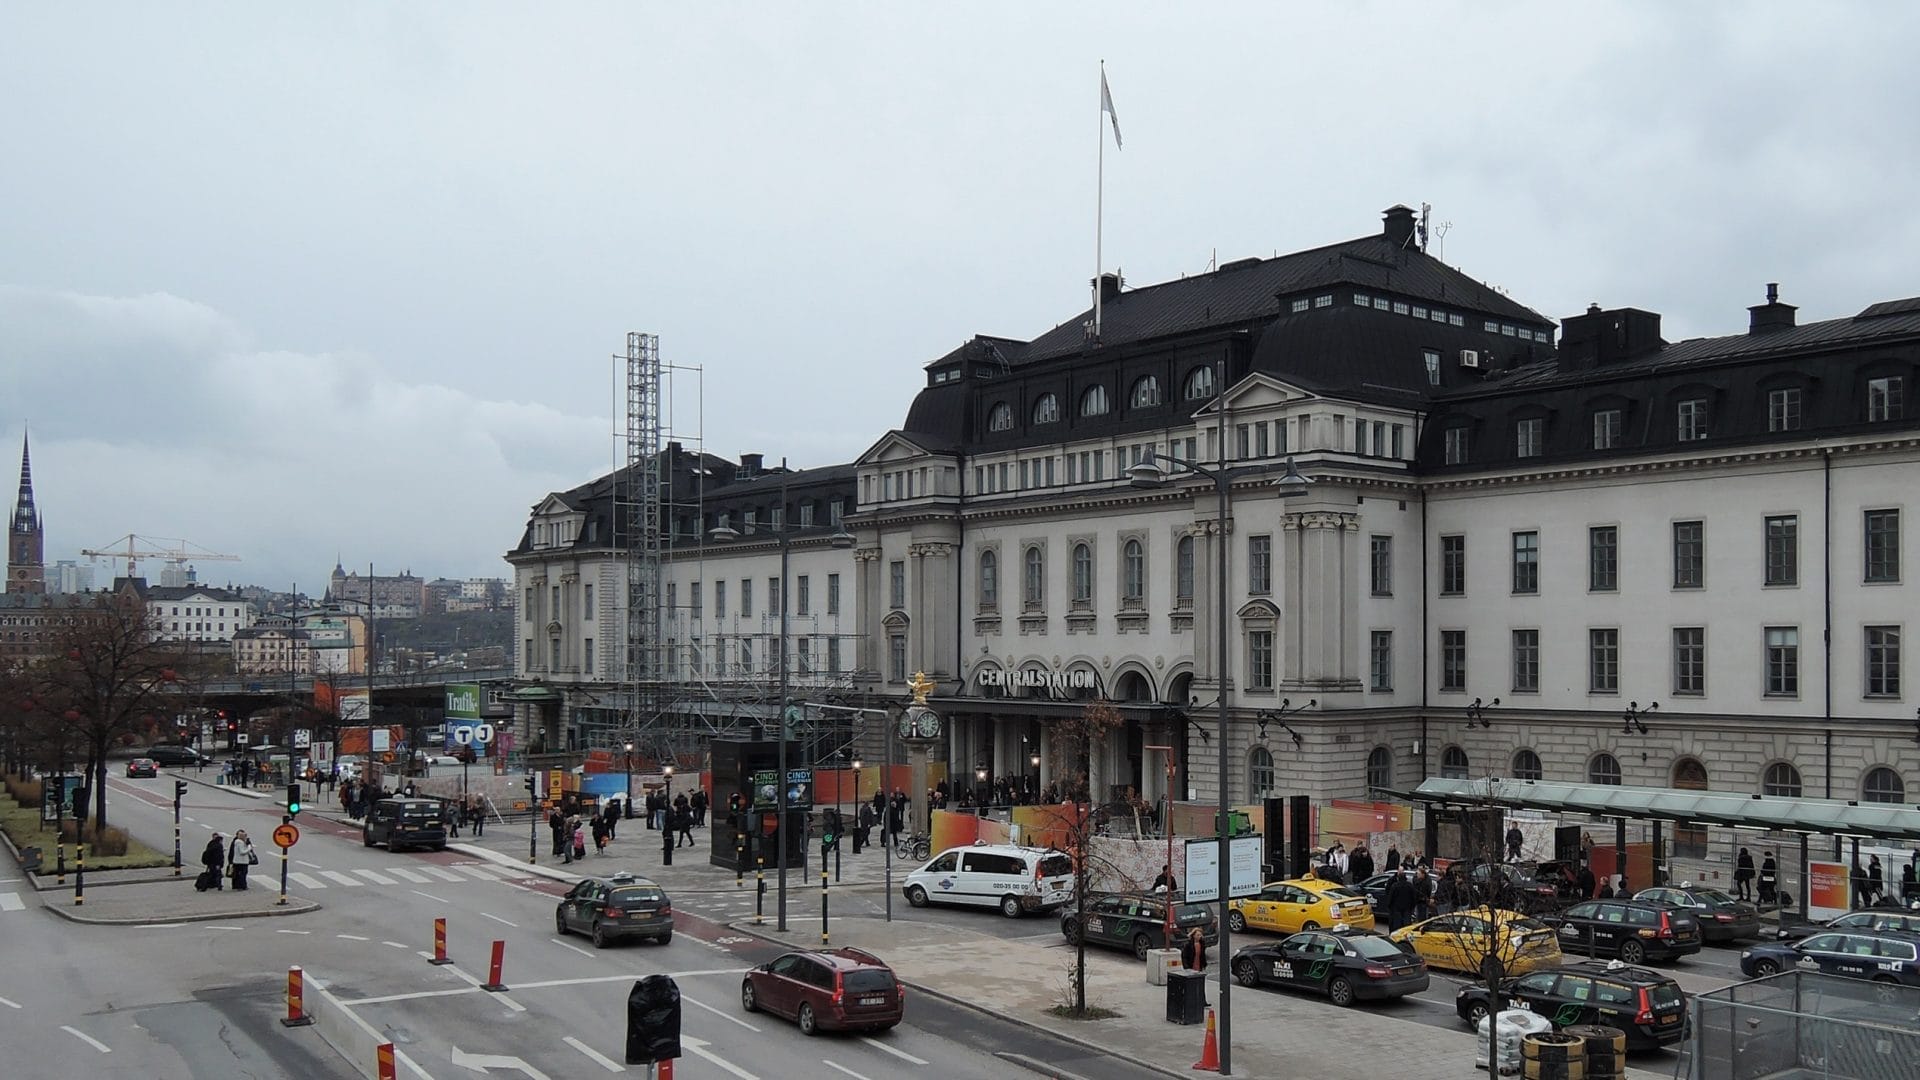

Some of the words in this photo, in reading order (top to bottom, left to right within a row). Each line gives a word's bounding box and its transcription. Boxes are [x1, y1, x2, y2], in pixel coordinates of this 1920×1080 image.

[979, 669, 1096, 689] CENTRALSTATION
[458, 730, 470, 742] T
[480, 727, 488, 740] J
[787, 771, 811, 779] CINDY
